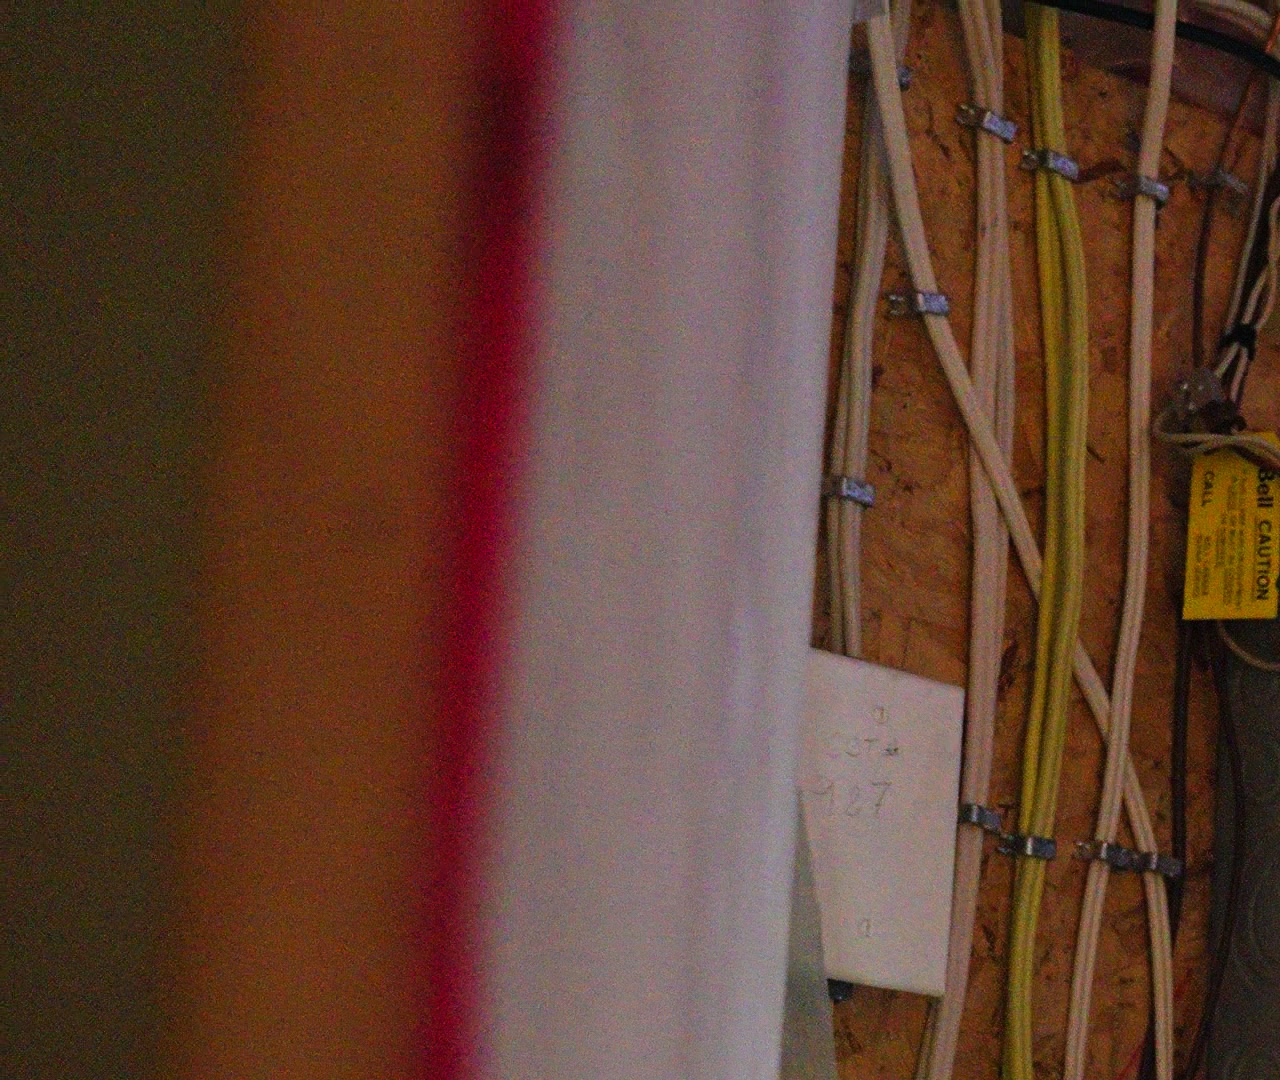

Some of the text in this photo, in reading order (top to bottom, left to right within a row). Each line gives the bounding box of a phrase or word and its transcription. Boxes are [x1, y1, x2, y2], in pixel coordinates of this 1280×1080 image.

[1202, 471, 1214, 507] CALL
[1256, 467, 1276, 601] Bell CAUTION
